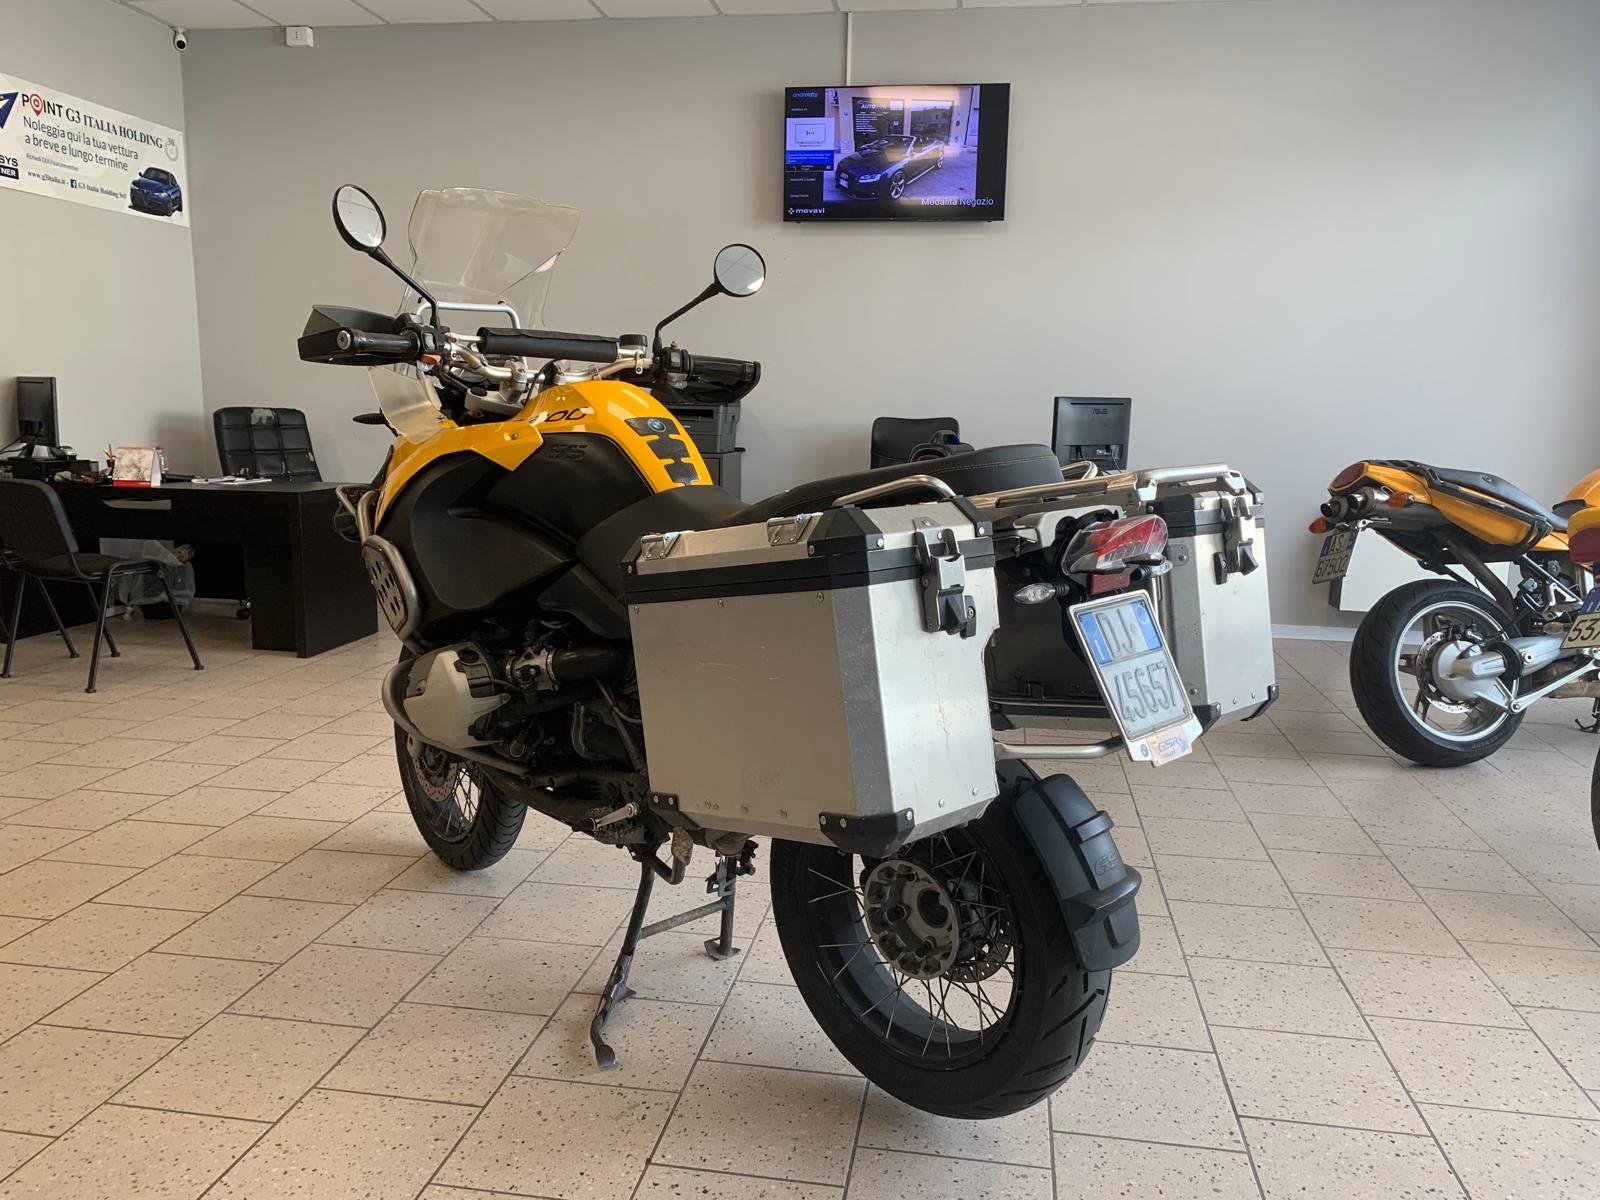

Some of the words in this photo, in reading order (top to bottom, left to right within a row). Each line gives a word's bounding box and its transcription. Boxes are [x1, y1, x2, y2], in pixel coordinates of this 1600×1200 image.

[21, 93, 63, 117] POINT
[66, 108, 81, 124] G3
[83, 114, 118, 136] ITALIA
[118, 125, 163, 149] HOLDING
[23, 115, 66, 139] Noleggia
[66, 131, 81, 143] qui
[83, 132, 91, 146] la
[92, 136, 107, 150] tua
[108, 143, 139, 160] vettura
[0, 154, 19, 167] SYS
[24, 134, 31, 144] a
[32, 133, 60, 153] breve
[61, 144, 67, 155] e
[69, 143, 94, 163] lungo
[95, 153, 129, 171] termine
[960, 196, 994, 208] Negozio
[1113, 661, 1177, 722] 45657
